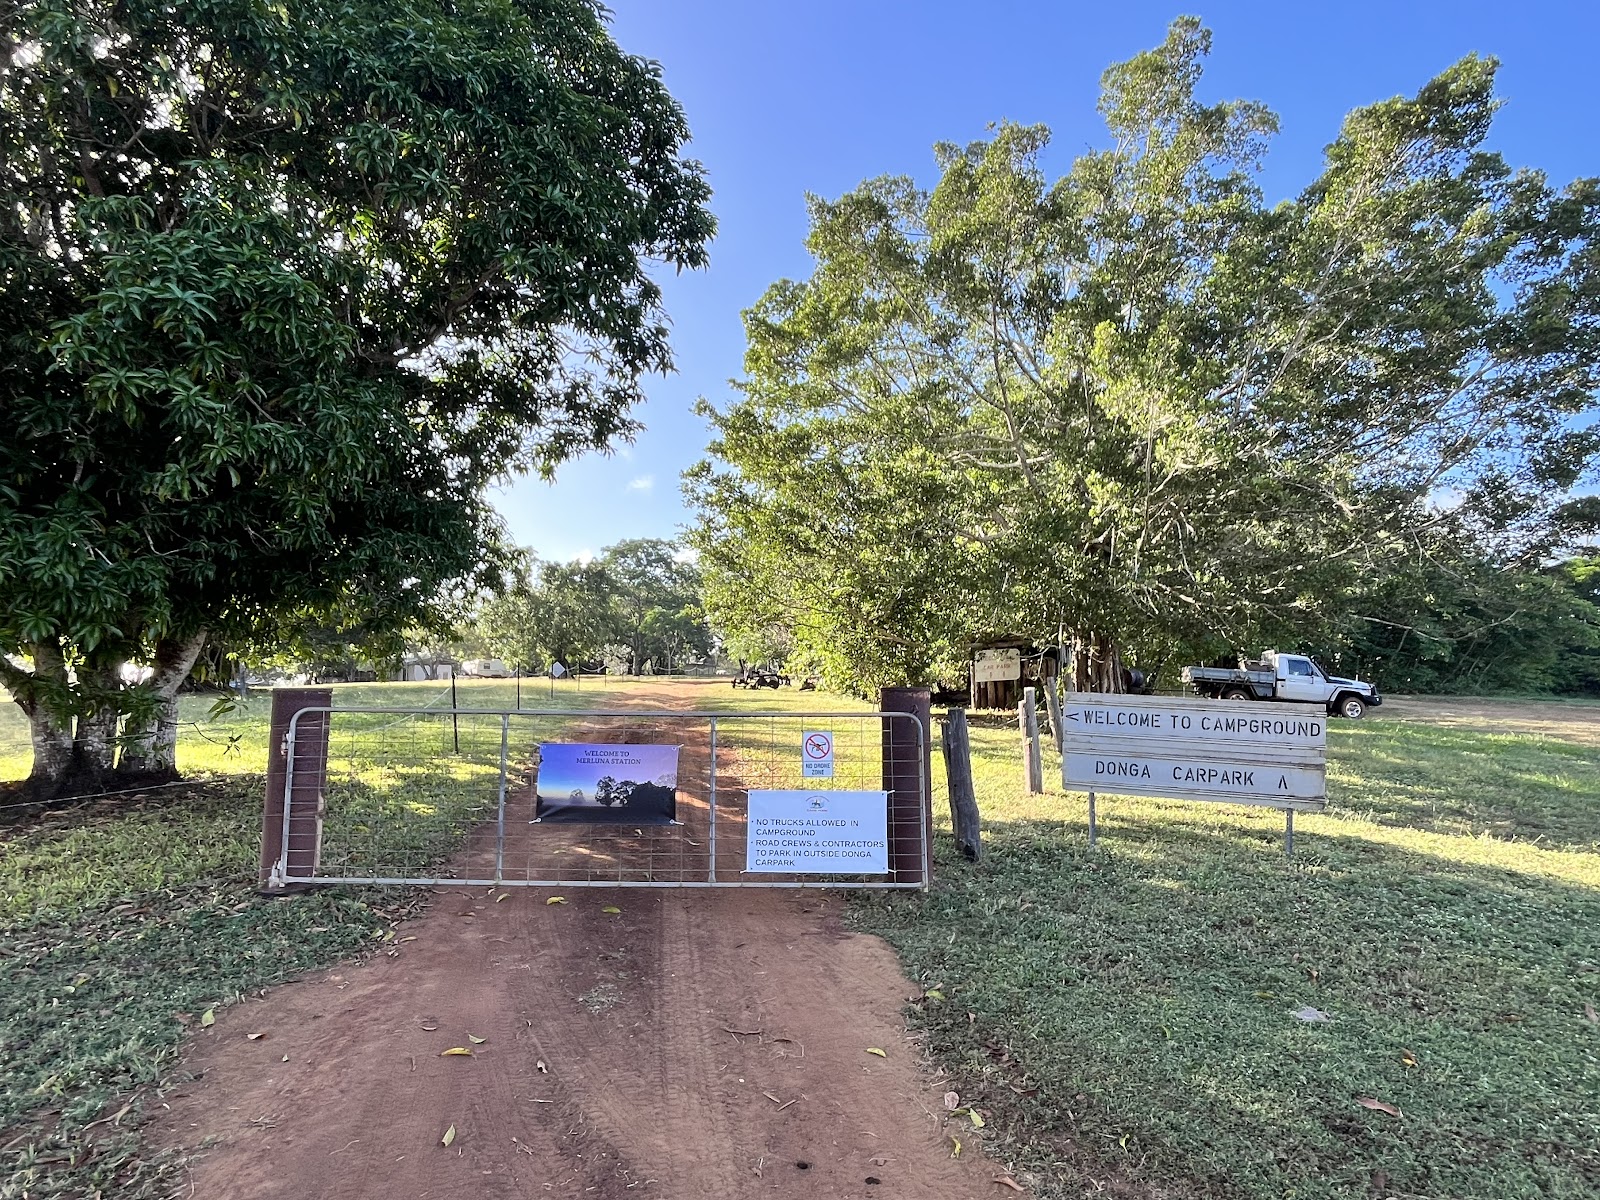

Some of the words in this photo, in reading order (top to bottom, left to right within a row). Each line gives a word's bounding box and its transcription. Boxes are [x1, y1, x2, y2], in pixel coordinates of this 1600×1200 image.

[1084, 710, 1160, 728] WELCOME
[1170, 715, 1191, 729] TO
[1201, 717, 1321, 737] CAMPGROUND
[1096, 761, 1151, 778] DONGA
[1173, 766, 1254, 786] CARPARK
